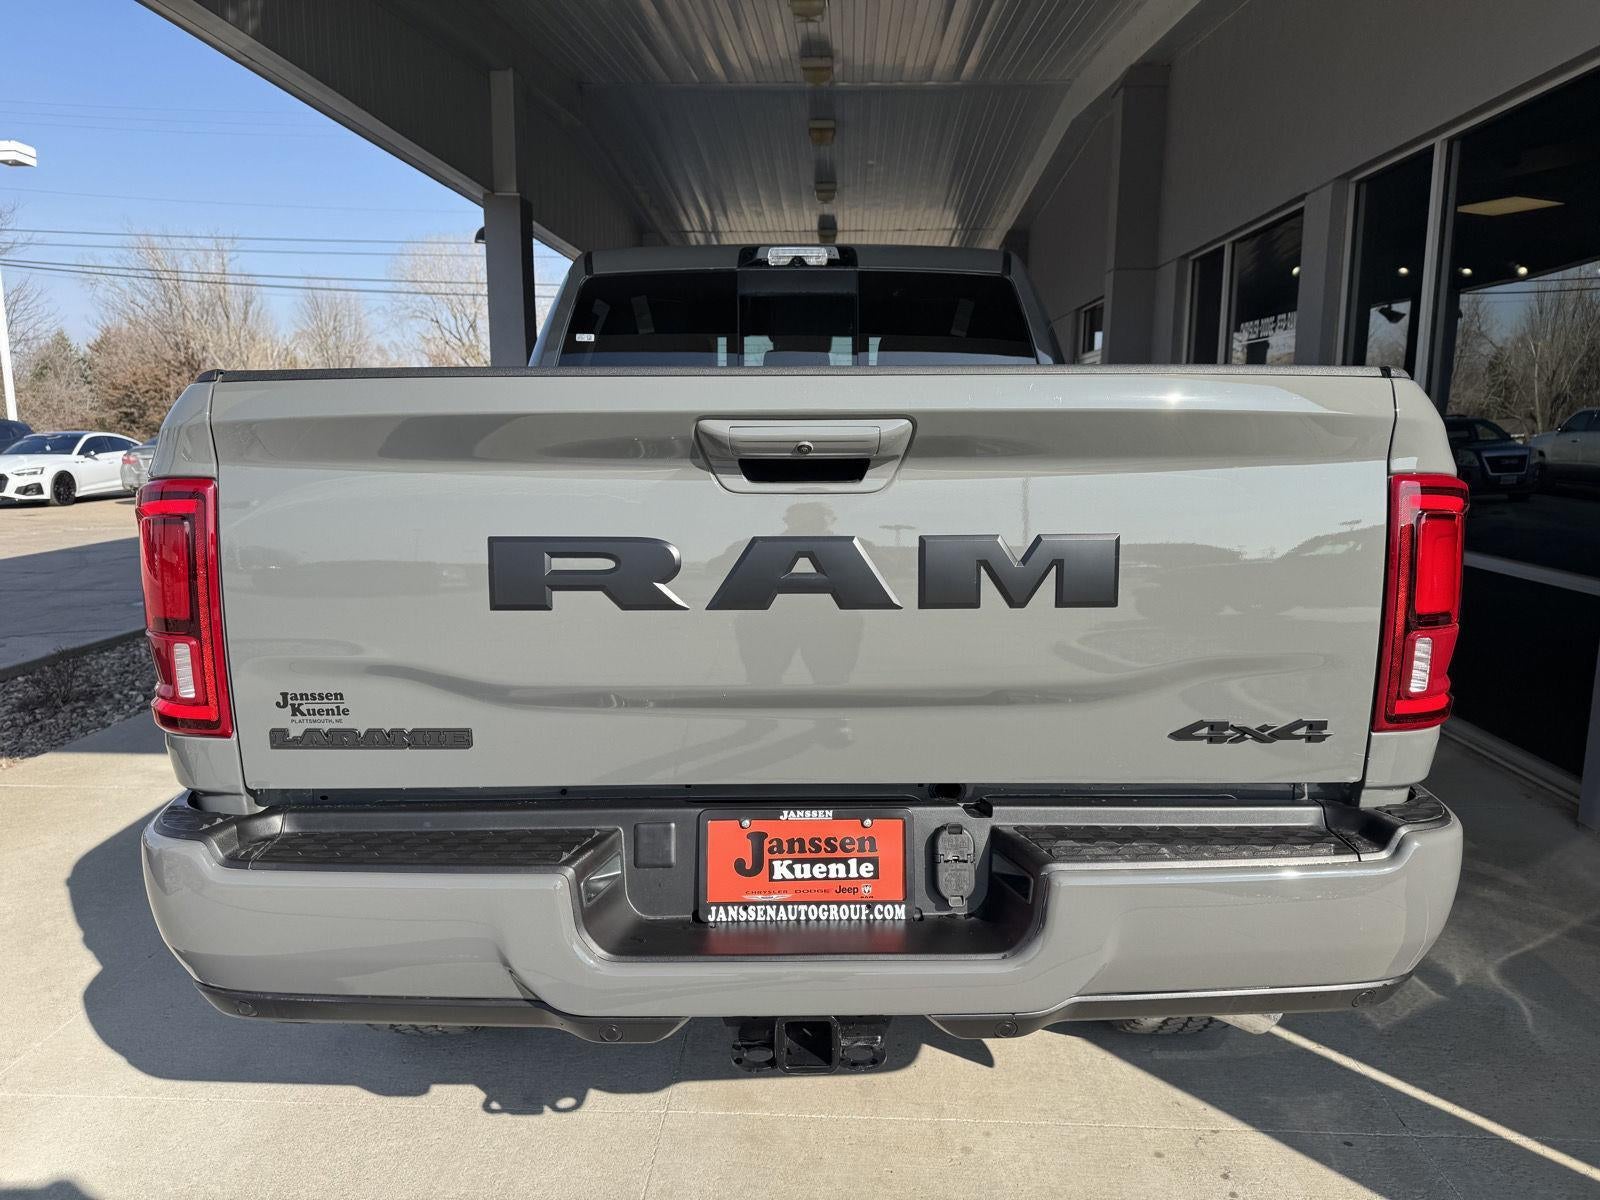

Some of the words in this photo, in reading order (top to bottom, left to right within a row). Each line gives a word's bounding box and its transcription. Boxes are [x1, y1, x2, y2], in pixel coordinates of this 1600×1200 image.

[487, 533, 1121, 611] RAM
[275, 691, 345, 709] Janssen
[290, 703, 350, 717] Kuenle
[269, 727, 474, 750] LARAMIE
[780, 809, 834, 821] JANSSEN
[734, 831, 878, 878] Janssen
[772, 858, 874, 880] Kuenle
[834, 885, 859, 896] Jeep
[707, 904, 906, 922] JANSSENAUTOGROUP.COM
